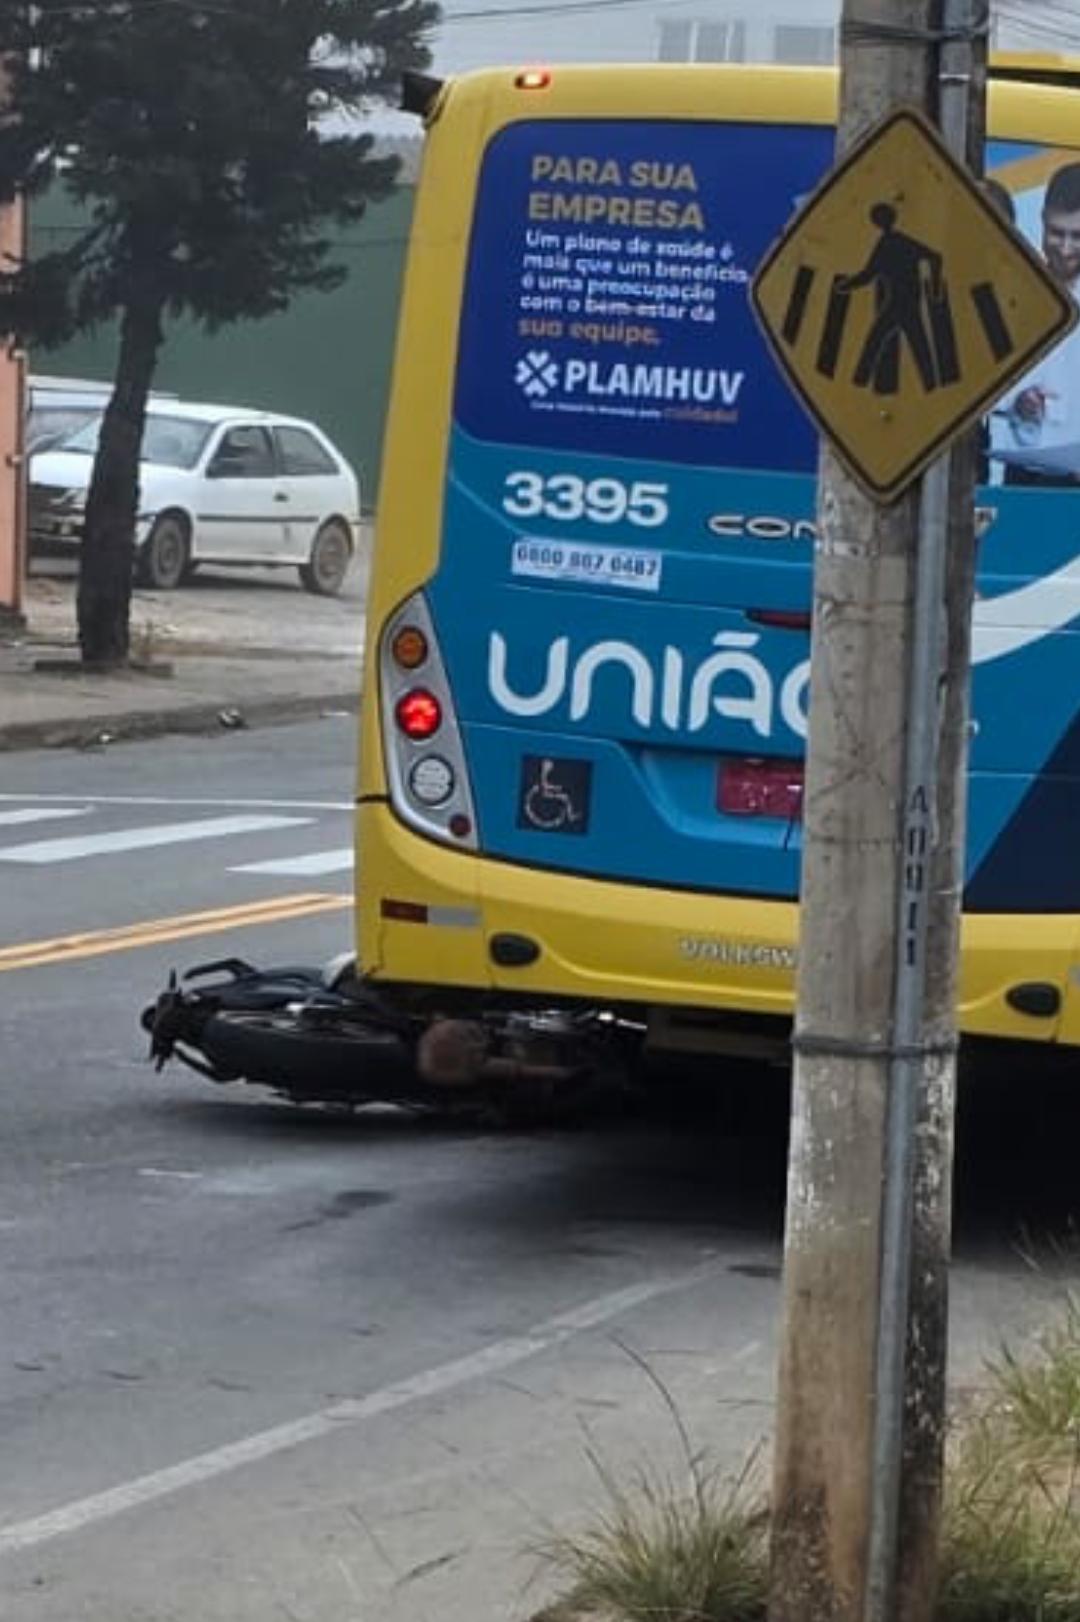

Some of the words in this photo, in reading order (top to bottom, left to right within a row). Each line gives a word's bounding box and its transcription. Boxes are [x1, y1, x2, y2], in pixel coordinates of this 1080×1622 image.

[532, 156, 621, 186] PARA
[629, 162, 697, 191] SUA
[529, 192, 704, 231] EMPRESA
[526, 229, 560, 248] Um
[565, 233, 621, 253] plano
[626, 236, 650, 252] de
[657, 239, 715, 263] saúde
[719, 241, 734, 260] é
[523, 254, 570, 271] mais
[575, 258, 613, 275] que
[617, 260, 650, 275] um
[522, 274, 535, 289] é
[538, 276, 583, 291] uma
[587, 279, 716, 301] preocupação
[520, 296, 563, 312] com
[567, 299, 580, 312] o
[585, 298, 685, 319] bem-estar
[518, 319, 562, 337] sua
[564, 360, 745, 404] PLAMHUV
[502, 471, 669, 527] 3395
